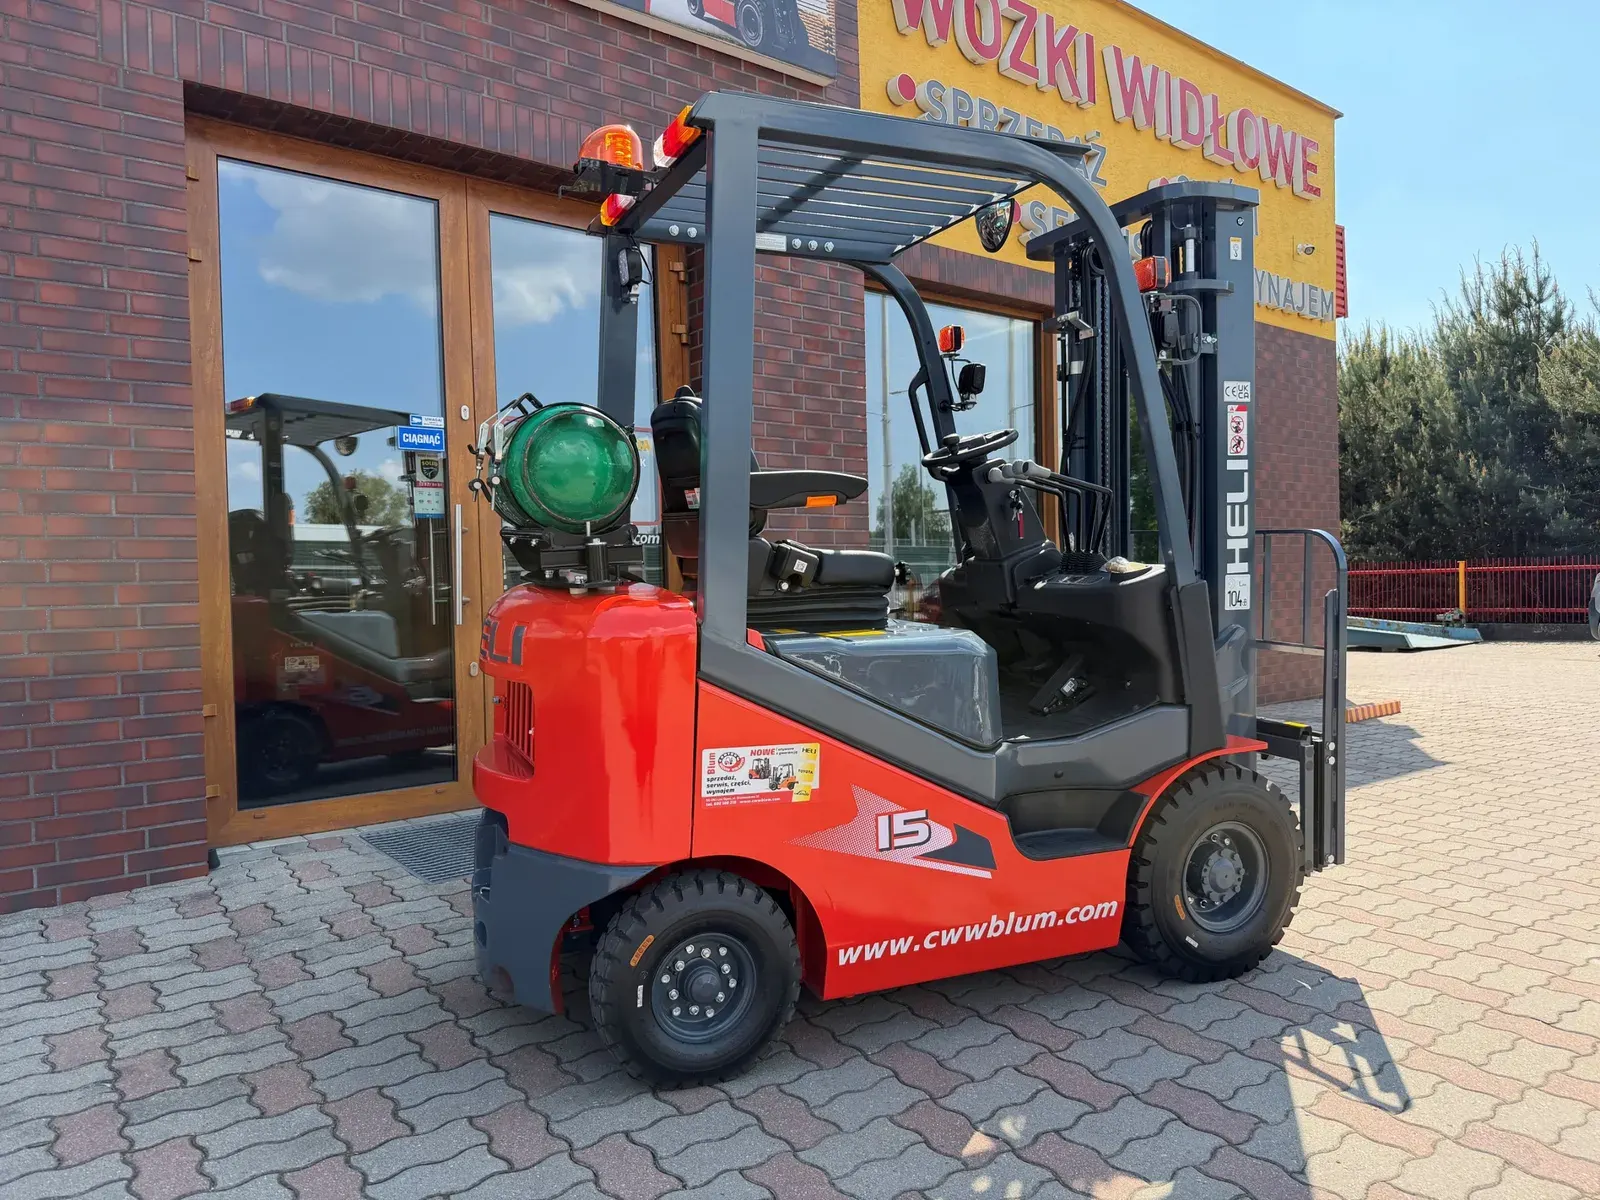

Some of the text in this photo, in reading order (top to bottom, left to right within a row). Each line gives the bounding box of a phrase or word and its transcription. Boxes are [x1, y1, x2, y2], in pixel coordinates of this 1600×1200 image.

[1102, 44, 1321, 200] WIDŁOWE
[1253, 267, 1334, 321] YNAJEM
[402, 432, 441, 447] CIĄGNĄĆ
[1226, 459, 1249, 574] HELI
[706, 752, 716, 775] Blum
[750, 748, 776, 757] NOWE
[877, 808, 932, 852] 15
[837, 900, 1118, 967] www.cwwblum.com
